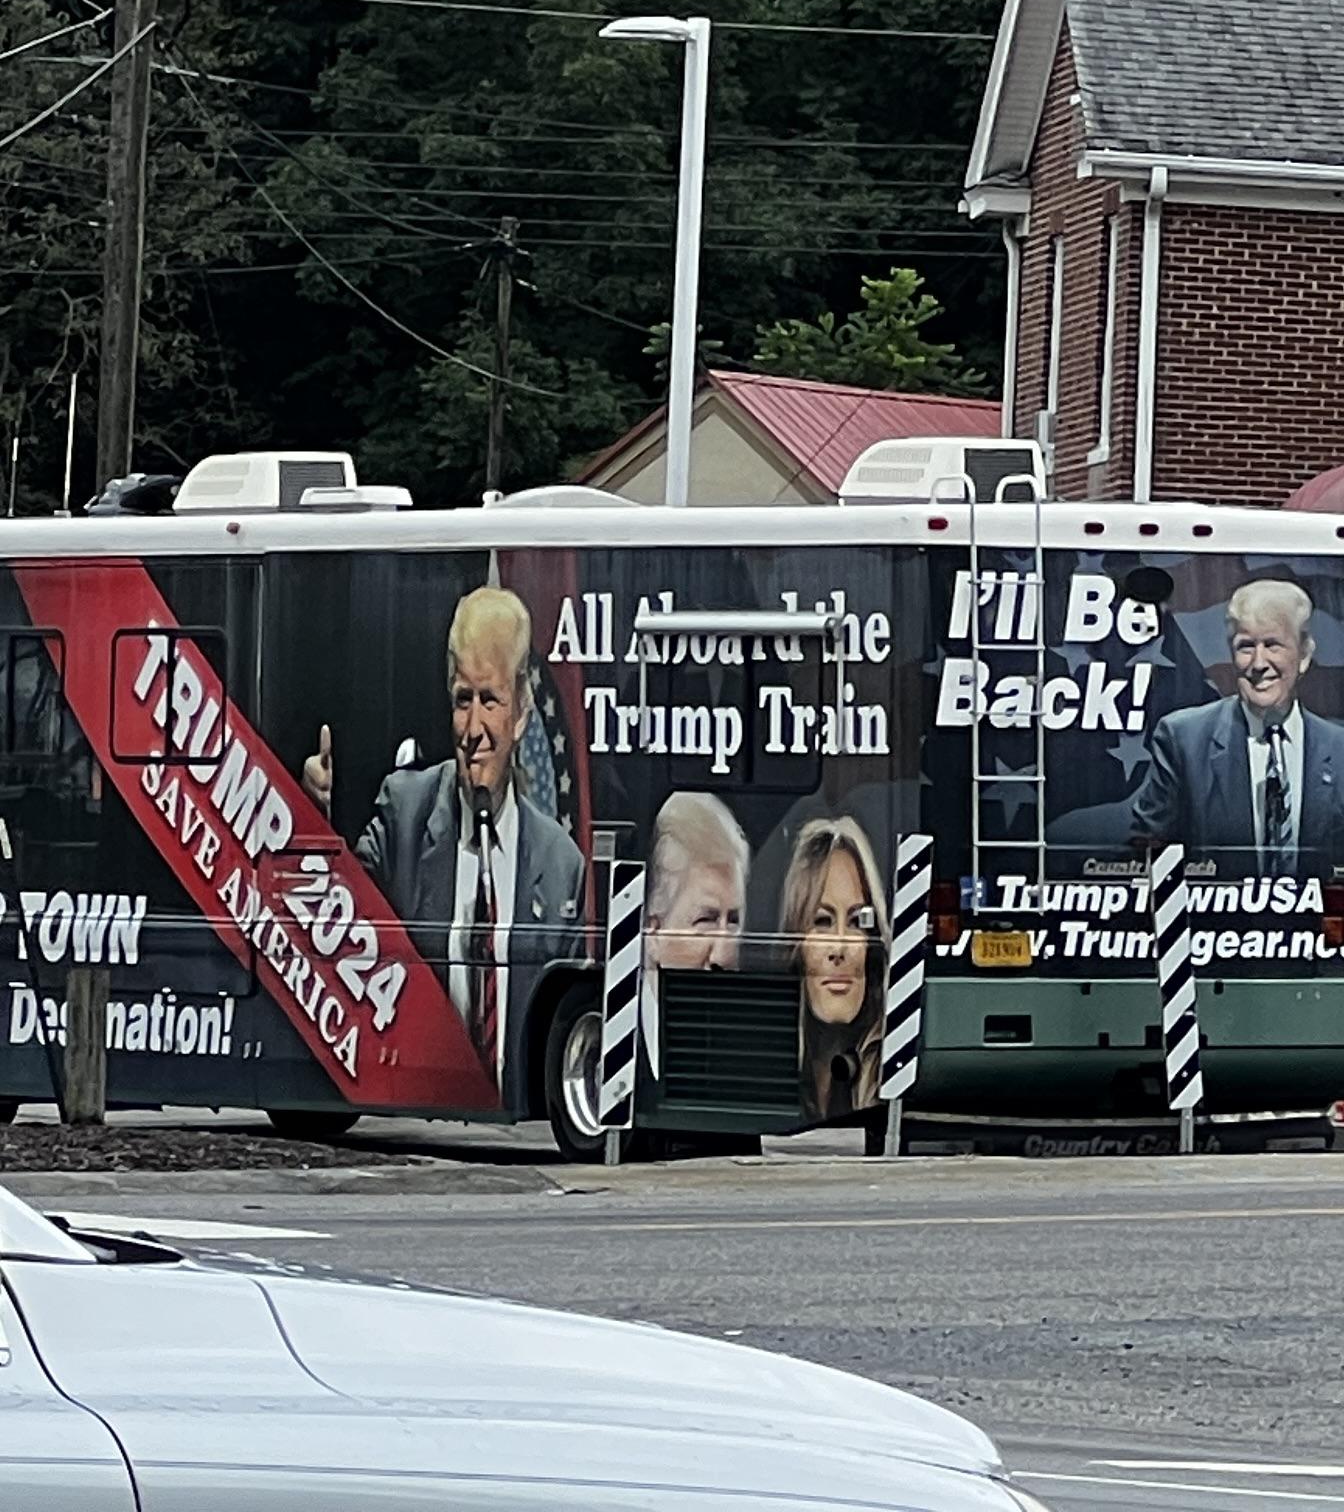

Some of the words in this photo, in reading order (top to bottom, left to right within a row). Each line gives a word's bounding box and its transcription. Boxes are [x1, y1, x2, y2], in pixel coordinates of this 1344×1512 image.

[547, 592, 615, 663] All
[624, 590, 804, 665] Aboard
[1063, 573, 1161, 646] Be
[584, 686, 743, 774] Trump
[758, 682, 891, 756] Train
[935, 656, 1153, 732] Back!
[134, 620, 293, 859] TRUMP
[282, 854, 407, 1032] 2024
[18, 890, 148, 965] TOWN
[141, 750, 222, 879] SAVE
[217, 867, 359, 1079] AMERICA
[996, 874, 1324, 920] TrumpTwnUSA
